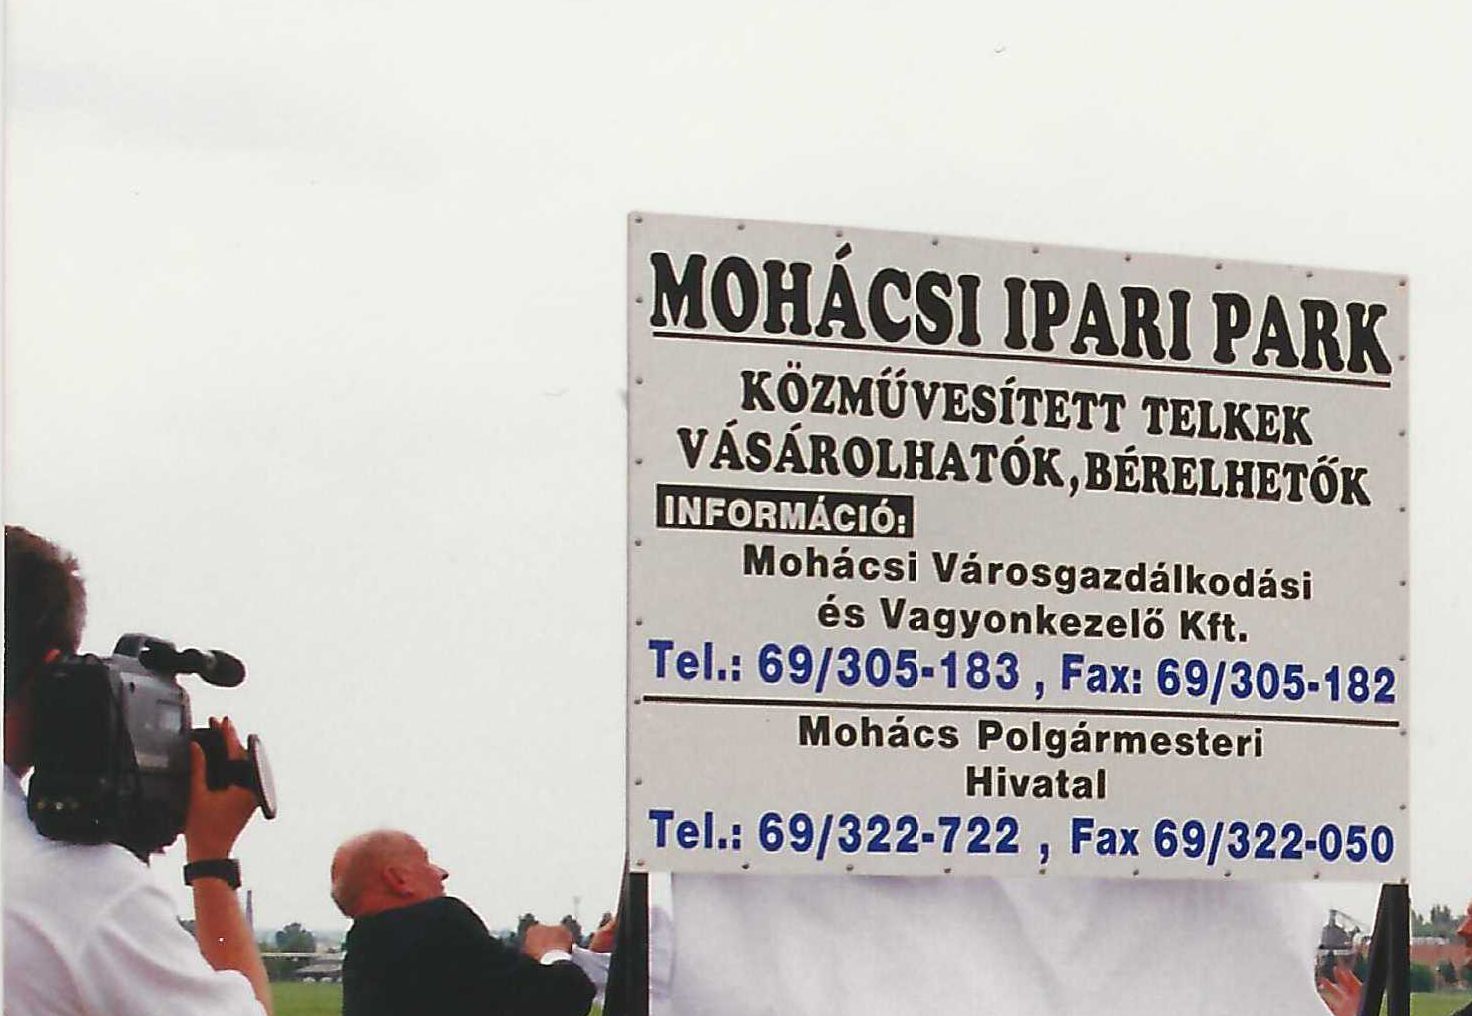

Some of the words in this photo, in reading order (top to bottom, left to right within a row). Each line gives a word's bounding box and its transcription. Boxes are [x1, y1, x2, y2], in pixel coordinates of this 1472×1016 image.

[650, 242, 981, 347] MOHÁCSI
[1004, 277, 1191, 361] IPARI
[1212, 293, 1392, 375] PARK
[741, 361, 1126, 433] KÖZMŰVESÍTETT
[1142, 396, 1312, 445] TELKEK
[666, 495, 905, 534] INFORMÁCIÓ:
[744, 544, 916, 581] Mohácsi
[932, 552, 1311, 600] Városgazdálkodási
[818, 594, 864, 628] és
[880, 598, 1164, 639] Vagyonkezelő
[1181, 610, 1247, 642] Kft.
[649, 640, 740, 681] Tel.:
[759, 644, 1018, 693] 69/305-183
[1062, 654, 1141, 694] Fax:
[1158, 659, 1395, 705] 69/305-182
[799, 716, 958, 748] Mohács
[979, 720, 1261, 759] Polgármesteri
[967, 766, 1105, 799] Hivatal
[649, 810, 740, 850] Tel.:
[759, 813, 1018, 860] 69/322-722
[1072, 818, 1139, 856] Fax
[1155, 819, 1393, 865] 69/322-050
